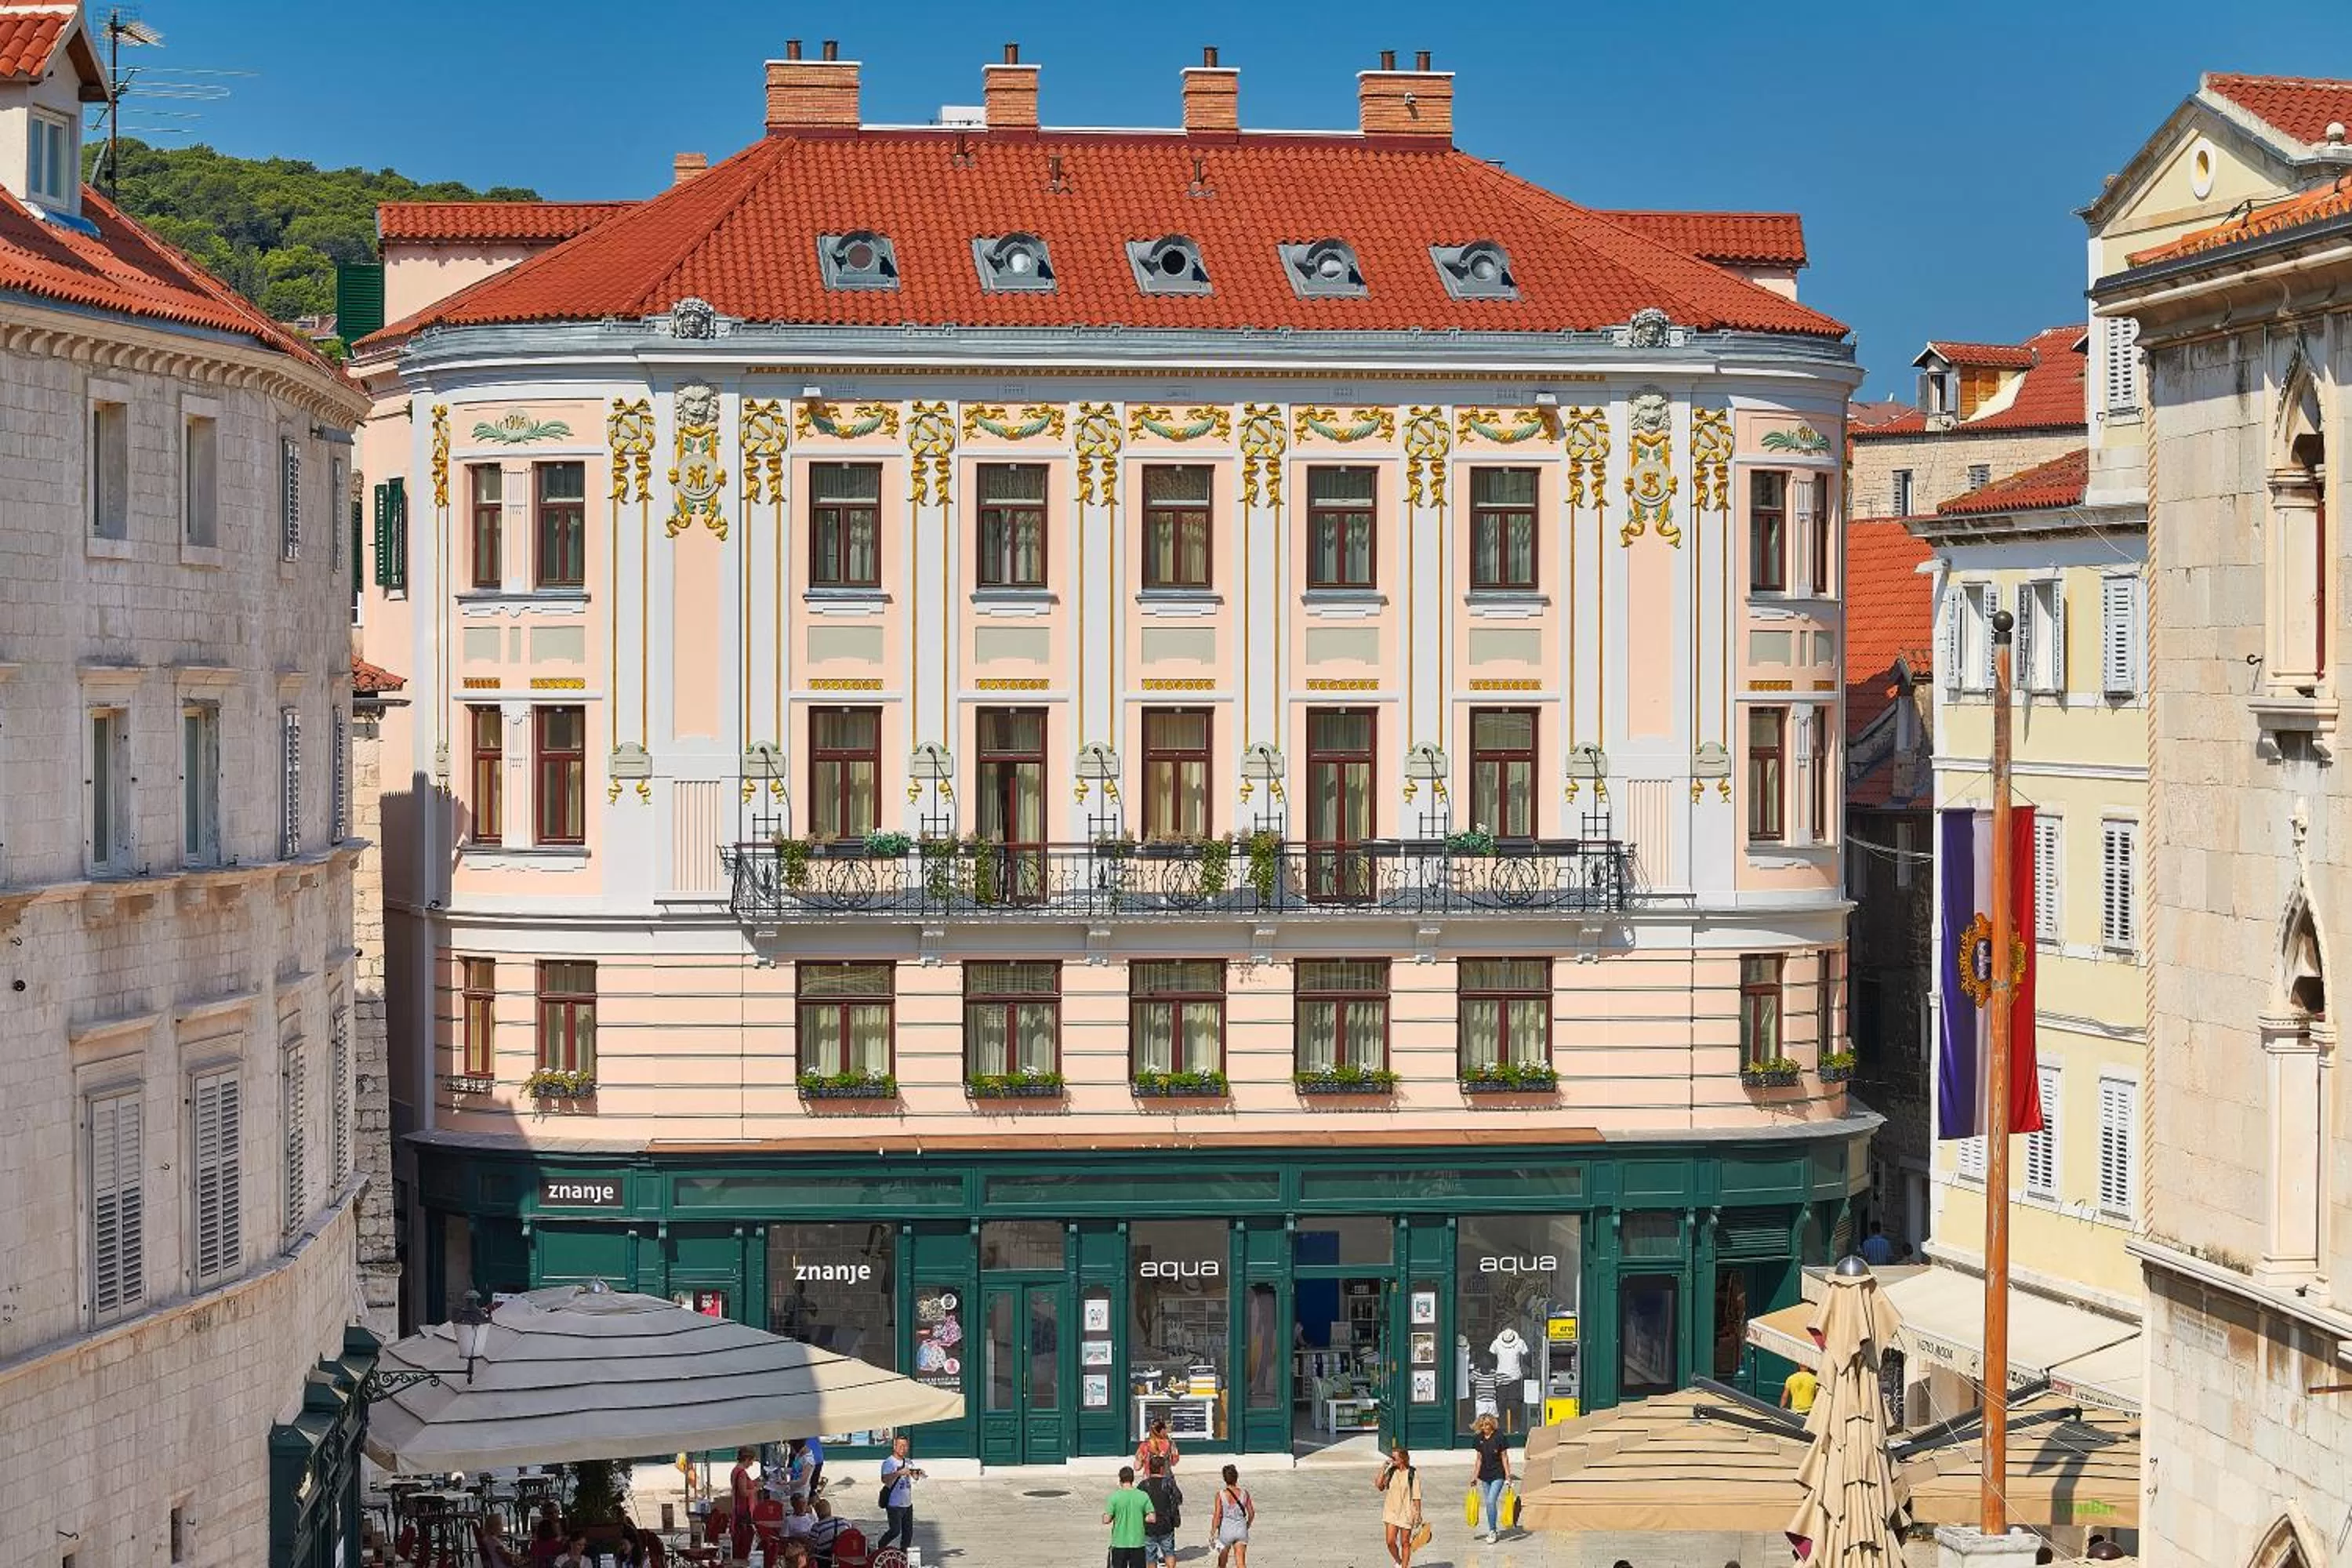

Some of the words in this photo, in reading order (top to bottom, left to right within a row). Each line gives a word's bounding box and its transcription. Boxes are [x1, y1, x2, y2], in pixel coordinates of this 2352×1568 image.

[548, 1185, 614, 1203] znanje
[795, 1265, 872, 1285] znanje
[1140, 1261, 1219, 1281] aqua
[1479, 1255, 1556, 1276] aqua
